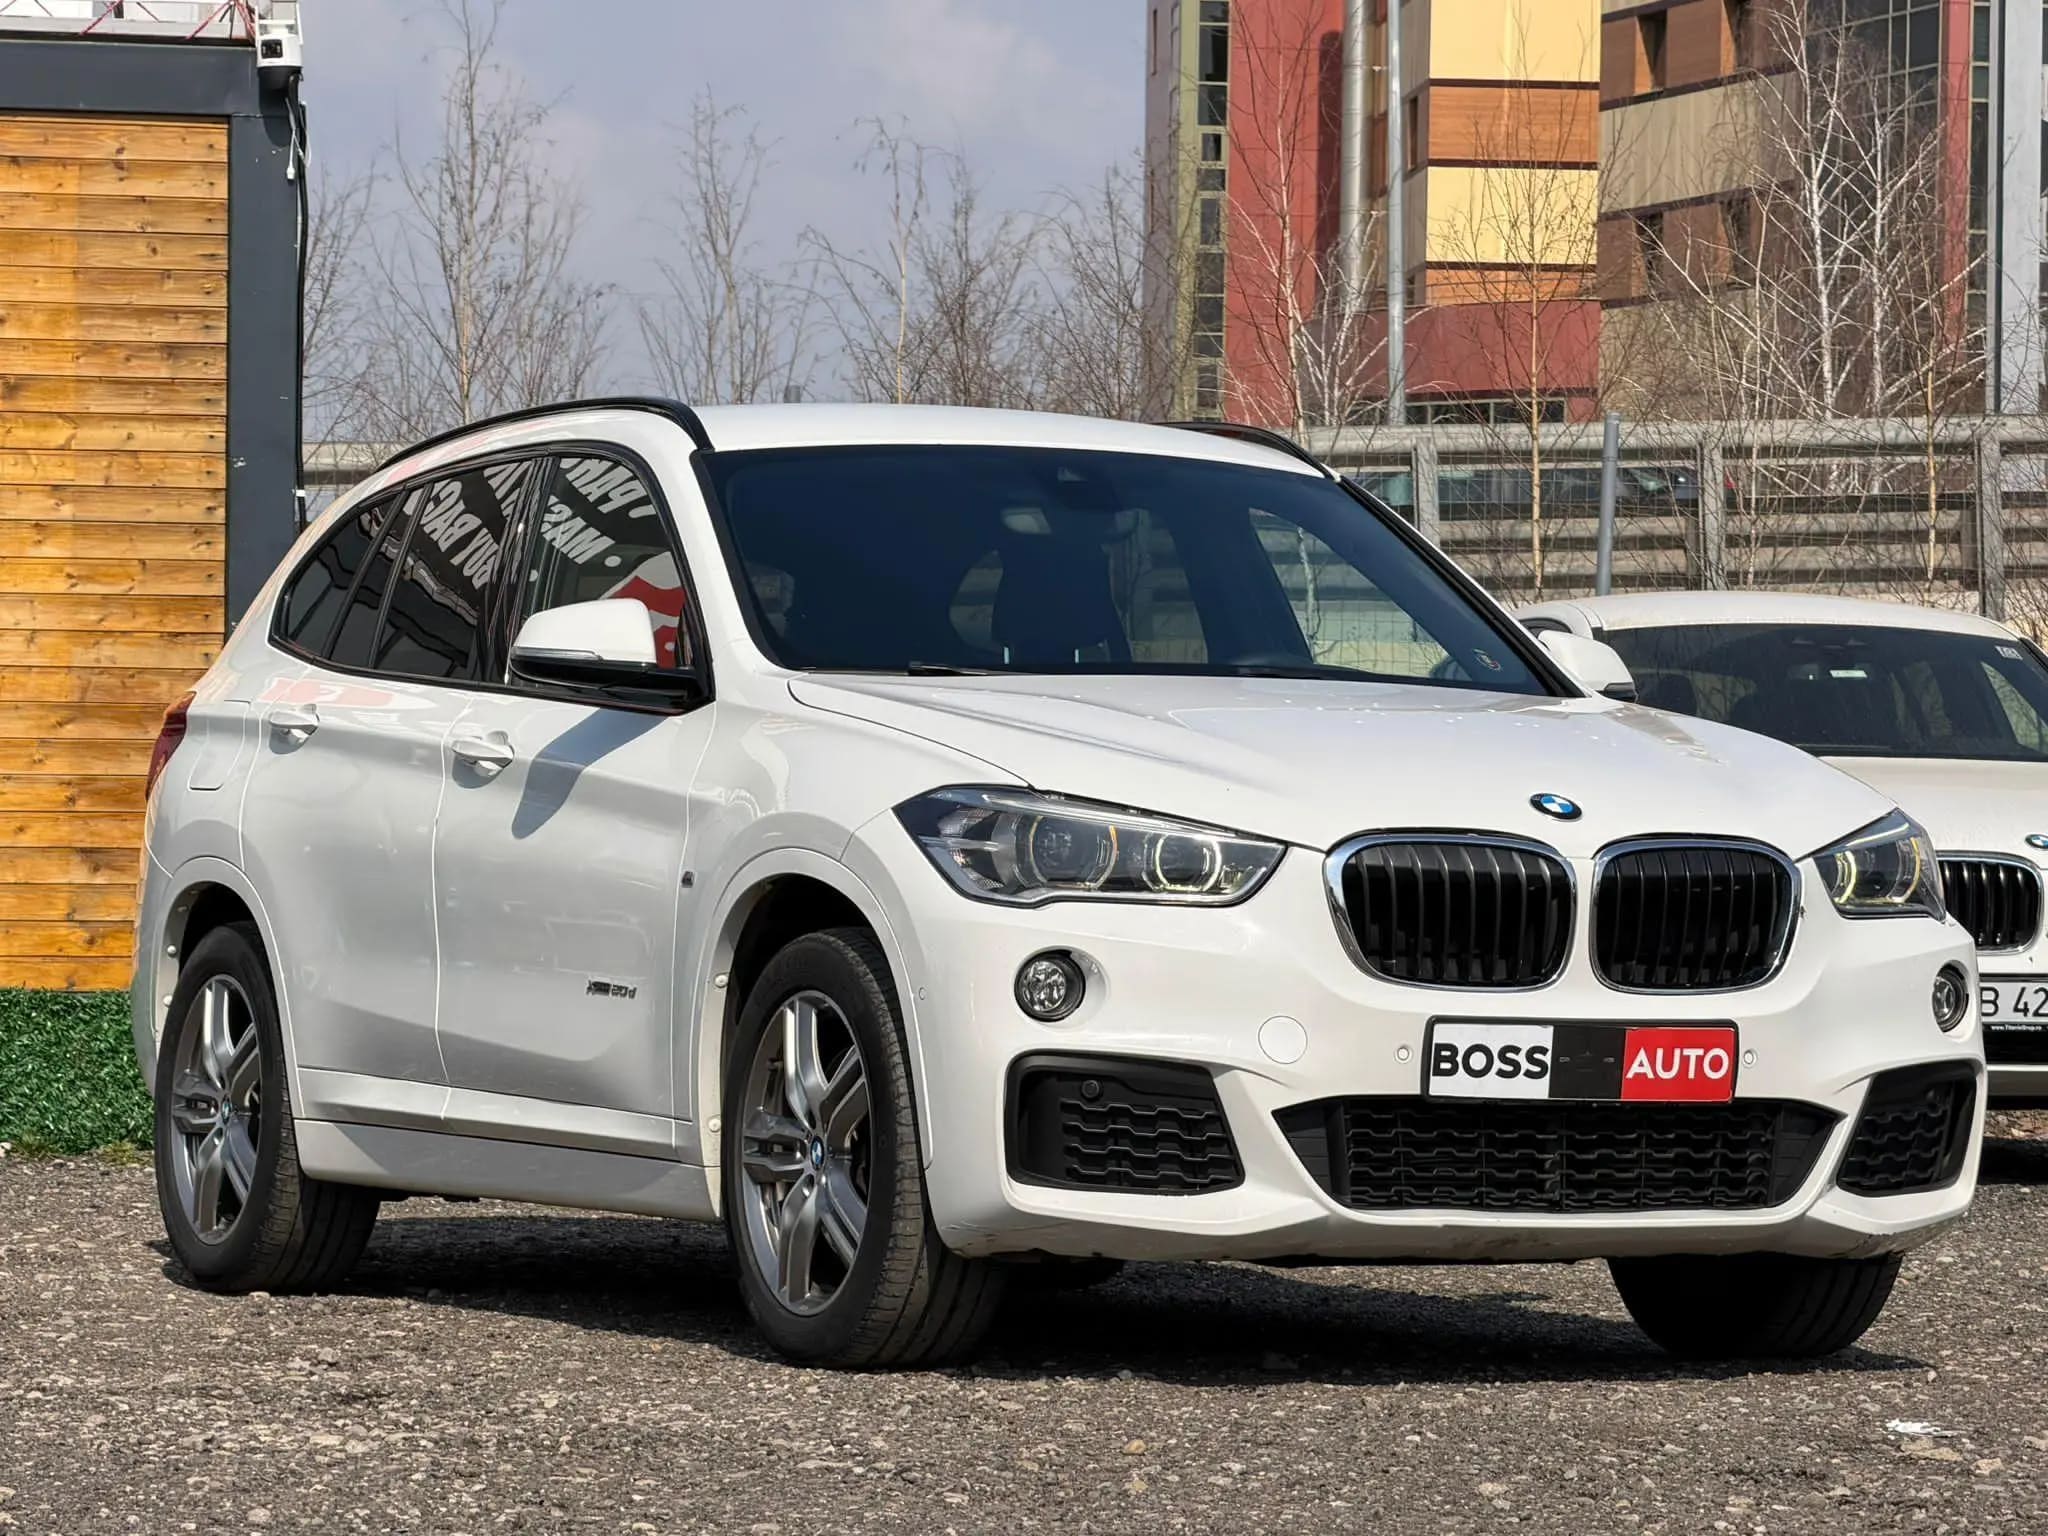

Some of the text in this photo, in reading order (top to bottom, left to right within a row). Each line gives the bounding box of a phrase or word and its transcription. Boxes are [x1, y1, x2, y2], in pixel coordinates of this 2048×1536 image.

[1981, 986, 2048, 1017] B 42
[1432, 1043, 1730, 1079] BOSS AUTO
